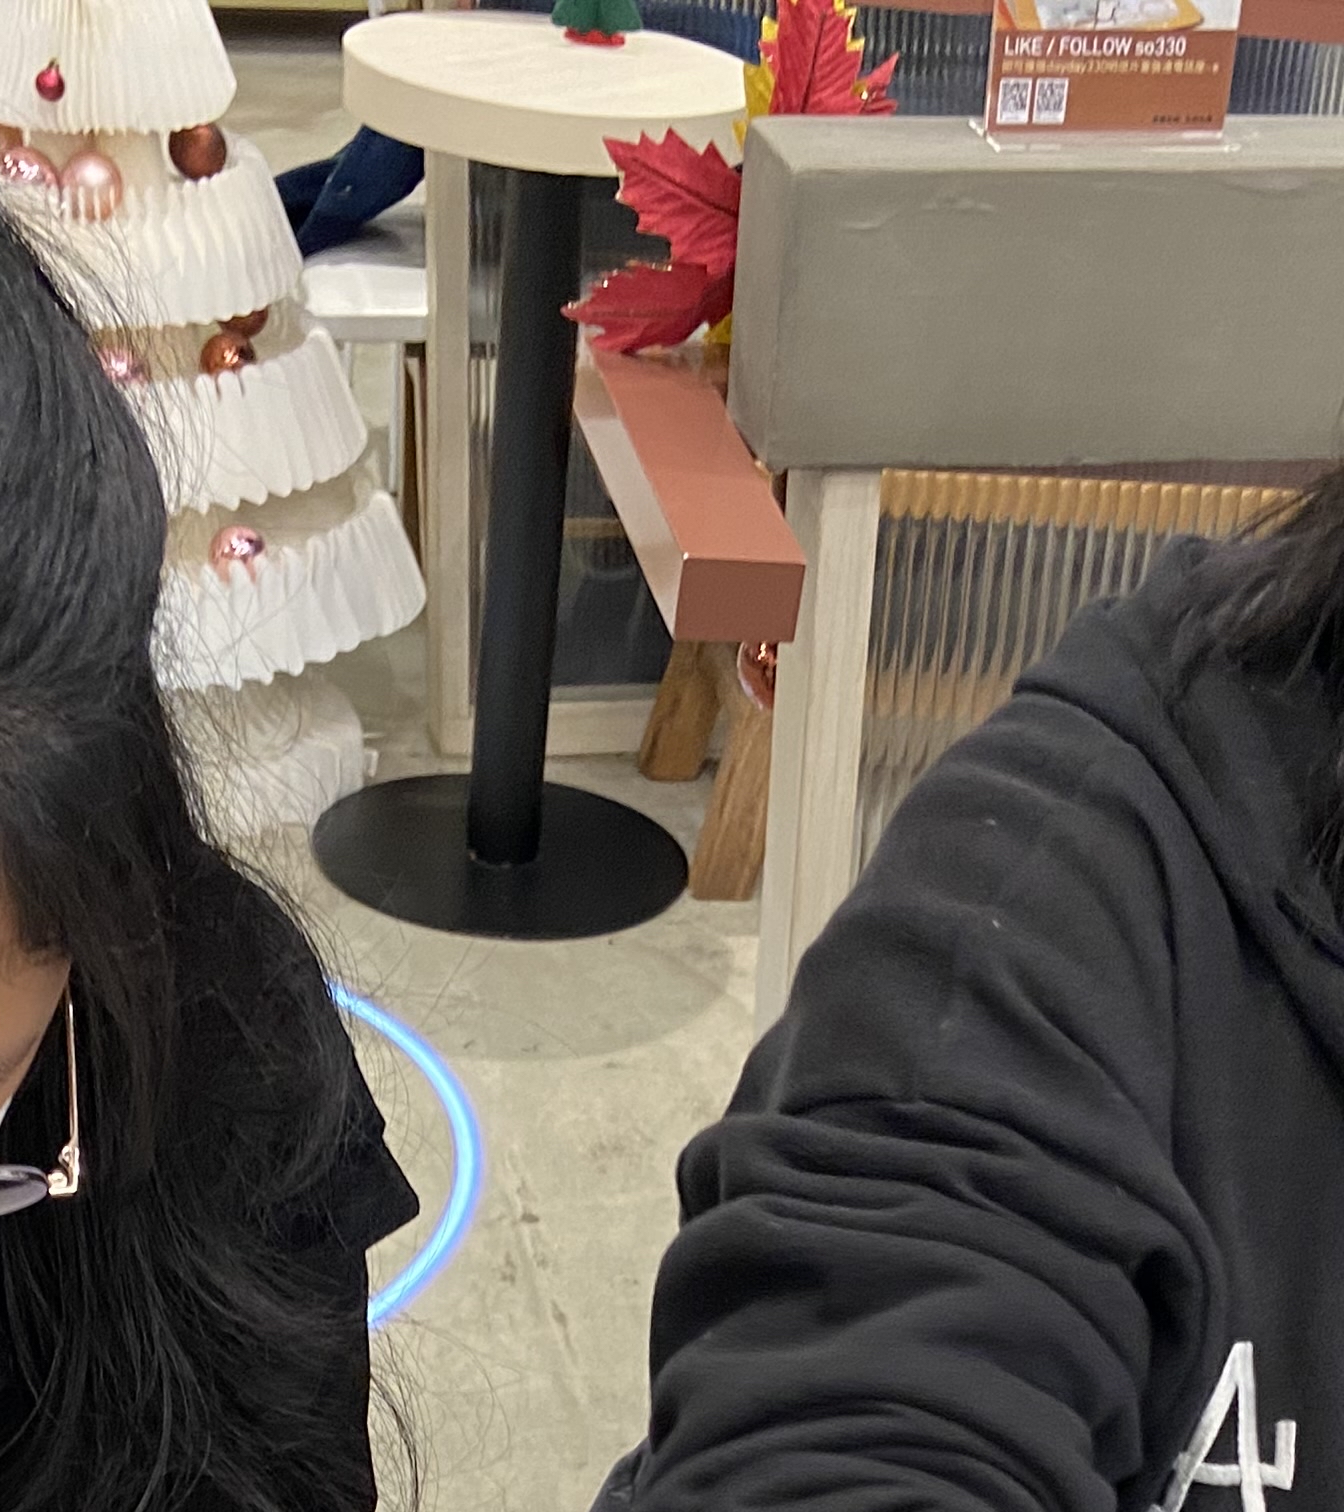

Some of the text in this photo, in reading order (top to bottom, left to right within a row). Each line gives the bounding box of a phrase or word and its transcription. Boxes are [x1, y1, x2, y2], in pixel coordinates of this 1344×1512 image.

[1004, 36, 1041, 57] LIKE
[1058, 36, 1133, 57] FOLLOW
[1134, 36, 1187, 57] so330
